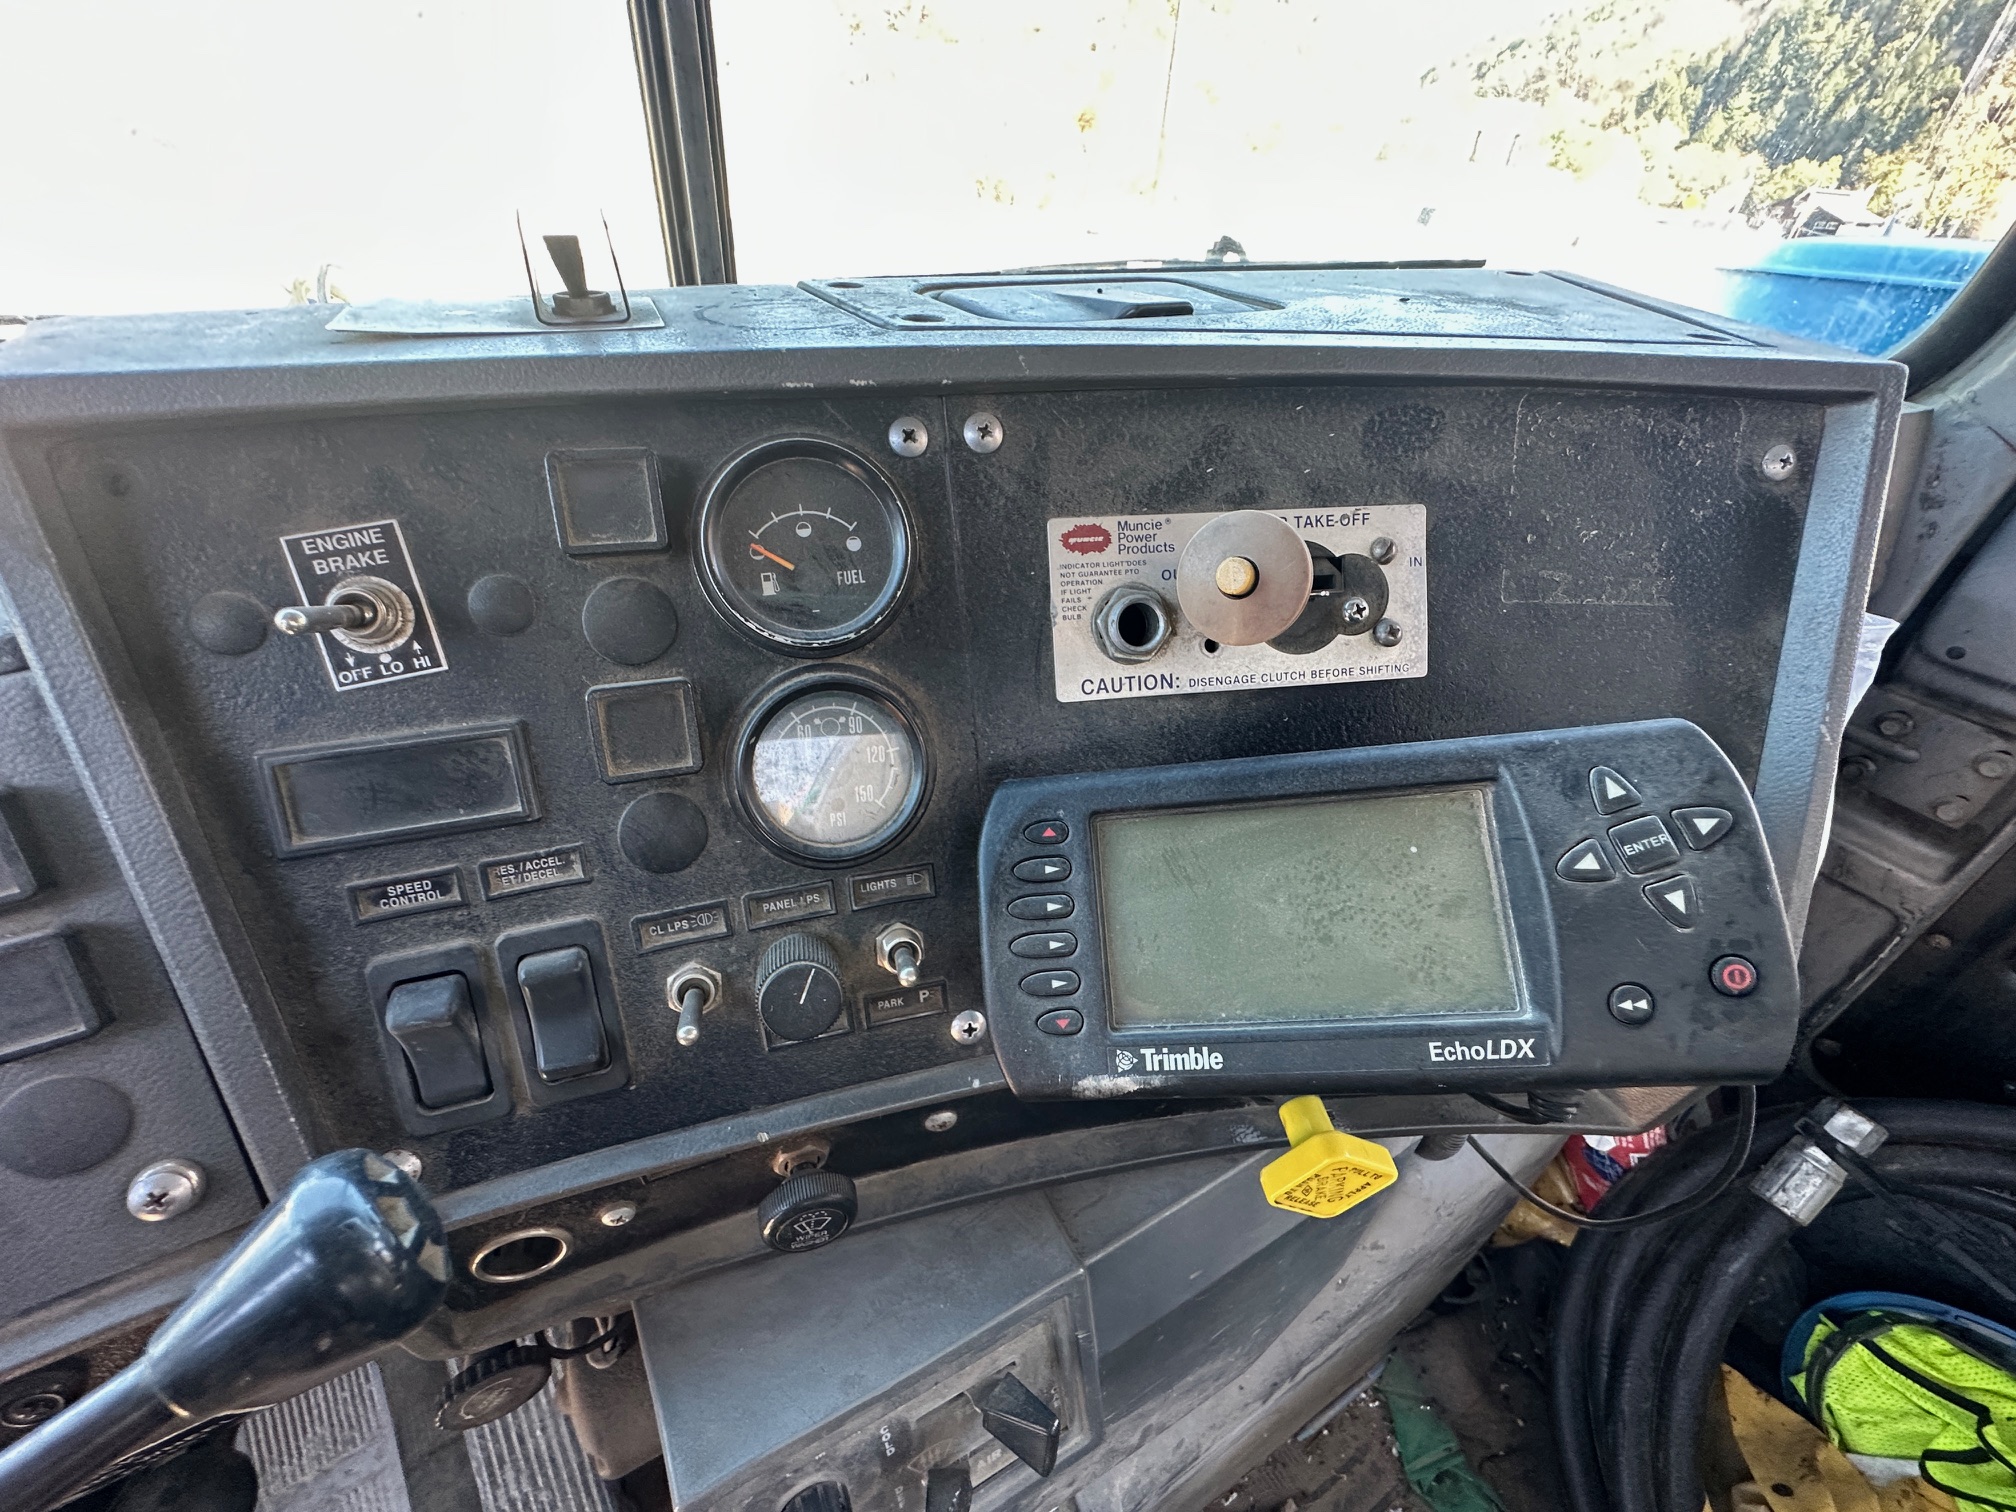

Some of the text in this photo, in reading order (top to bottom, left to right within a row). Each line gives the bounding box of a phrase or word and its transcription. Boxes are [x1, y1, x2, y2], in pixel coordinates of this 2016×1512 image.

[1294, 512, 1371, 528] TAKE-OFF
[301, 528, 386, 554] ENGINE
[1118, 532, 1158, 544] Power
[1118, 542, 1176, 555] Products
[312, 549, 390, 575] BRAKE
[1060, 561, 1100, 571] INDICATOR
[1102, 560, 1127, 568] LIGHT
[1409, 557, 1423, 567] IN
[836, 569, 866, 586] FUEL
[1078, 569, 1122, 577] GUARANTEE
[1060, 579, 1103, 587] OPERATION
[338, 655, 432, 684] OFF LO HI
[1081, 663, 1410, 695] CAUTION: DISENGAGE CLUTCH BEFORE SHIFTING
[848, 716, 863, 734] 90
[866, 745, 886, 763] 120
[854, 784, 874, 803] 150
[829, 812, 847, 827] PSI
[1623, 833, 1670, 856] ENTER
[387, 880, 433, 897] SPEED
[860, 878, 897, 893] LIGHTS
[380, 890, 446, 910] CONTROL
[762, 898, 797, 913] PANEL
[649, 919, 690, 936] CL LPS
[878, 997, 905, 1010] PARK
[1140, 1046, 1224, 1071] Trimble
[1428, 1038, 1536, 1062] EchoLDX
[880, 1425, 895, 1457] COLD
